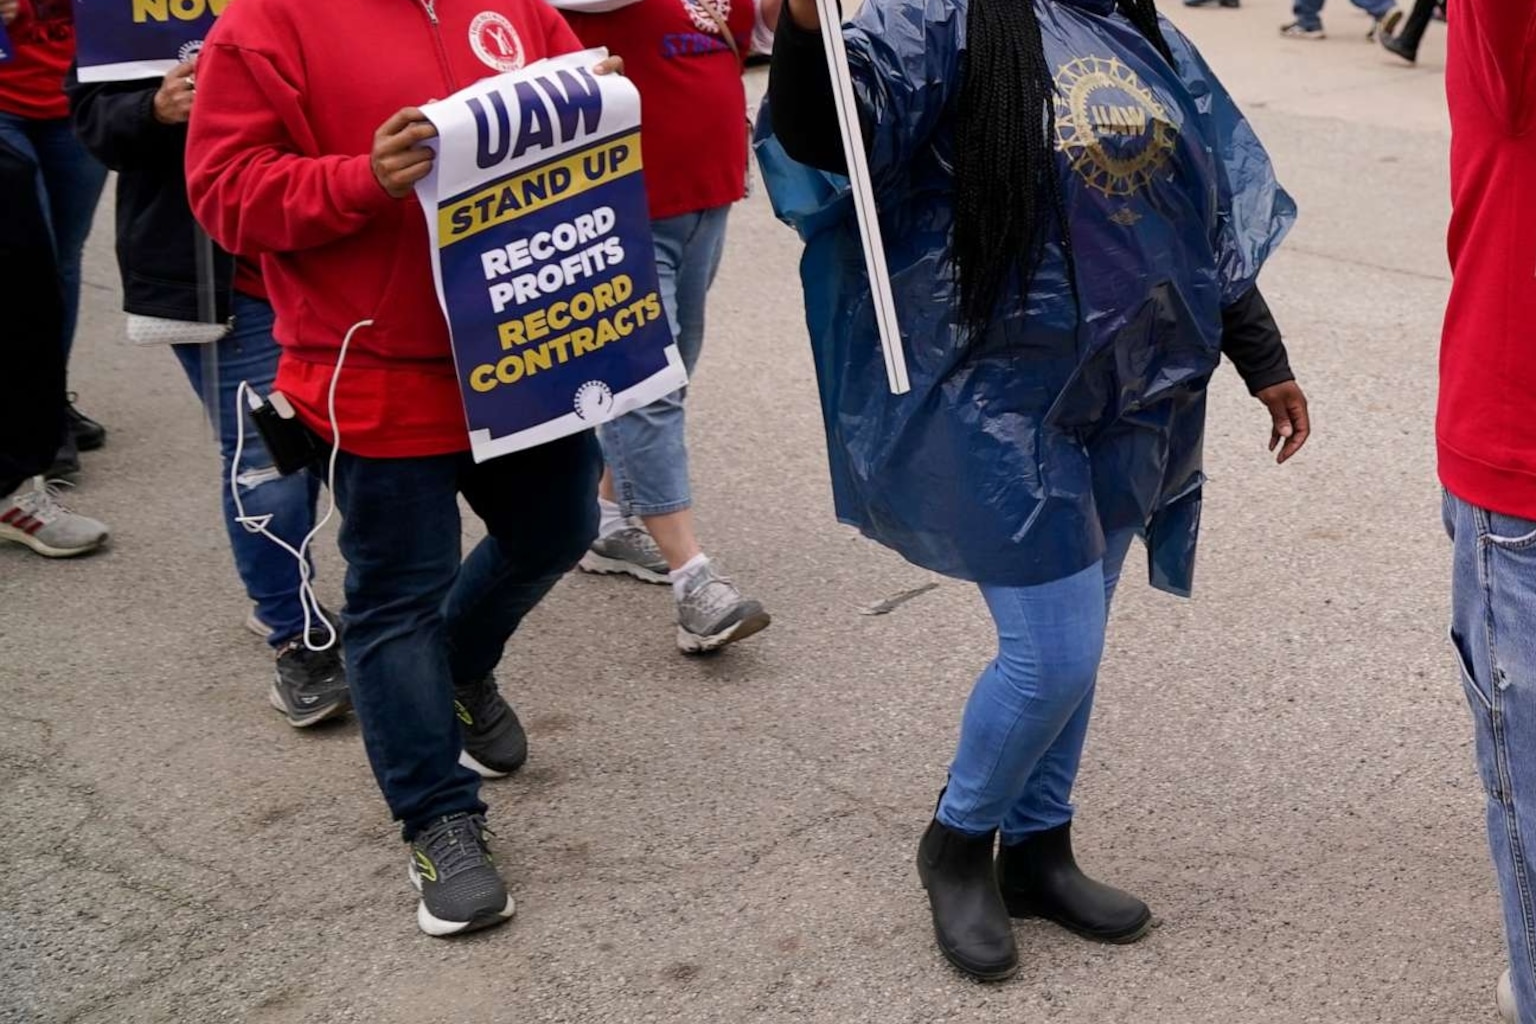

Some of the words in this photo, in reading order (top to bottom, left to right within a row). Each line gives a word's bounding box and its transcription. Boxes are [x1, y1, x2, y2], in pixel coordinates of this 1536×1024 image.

[466, 66, 603, 171] UAW
[1091, 105, 1146, 136] UAW
[450, 166, 571, 235] STAND
[583, 144, 629, 177] UP
[481, 206, 615, 280] RECORD
[488, 237, 624, 314] PROFITS
[469, 292, 662, 393] CONTRACTS
[498, 274, 634, 350] RECORD
